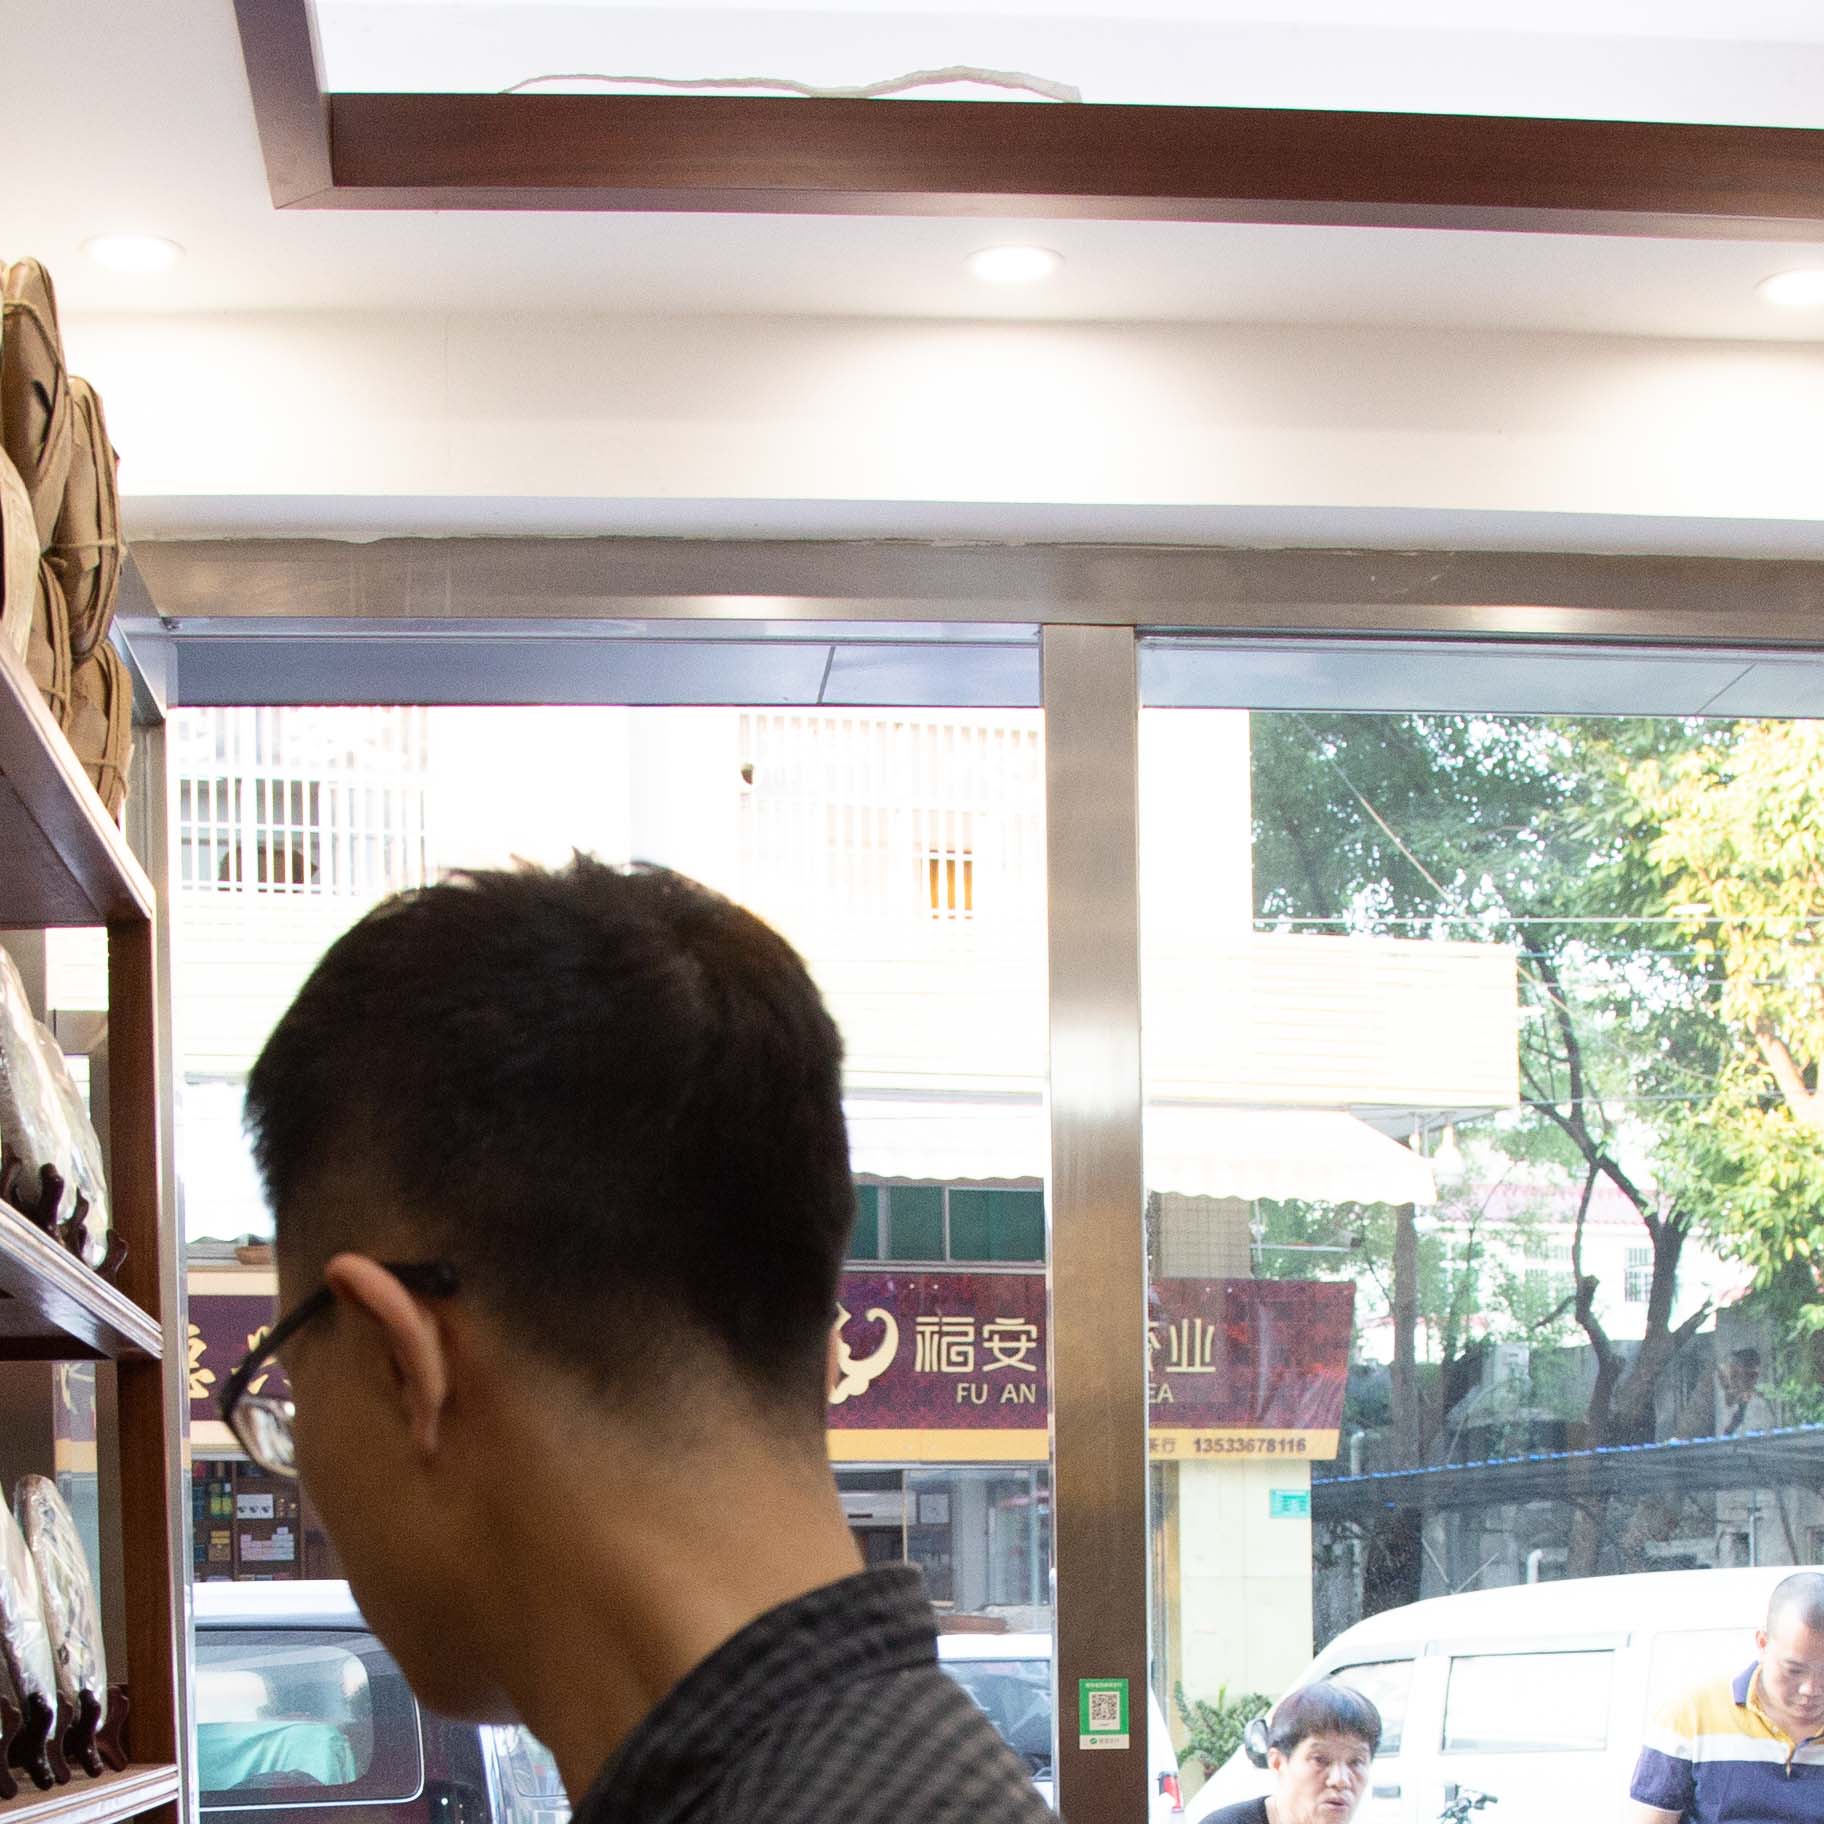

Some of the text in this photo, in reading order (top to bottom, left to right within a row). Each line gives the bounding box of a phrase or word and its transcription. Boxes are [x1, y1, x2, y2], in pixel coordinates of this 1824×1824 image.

[914, 1315, 1039, 1375] 福安
[956, 1382, 1175, 1404] FU AN EA
